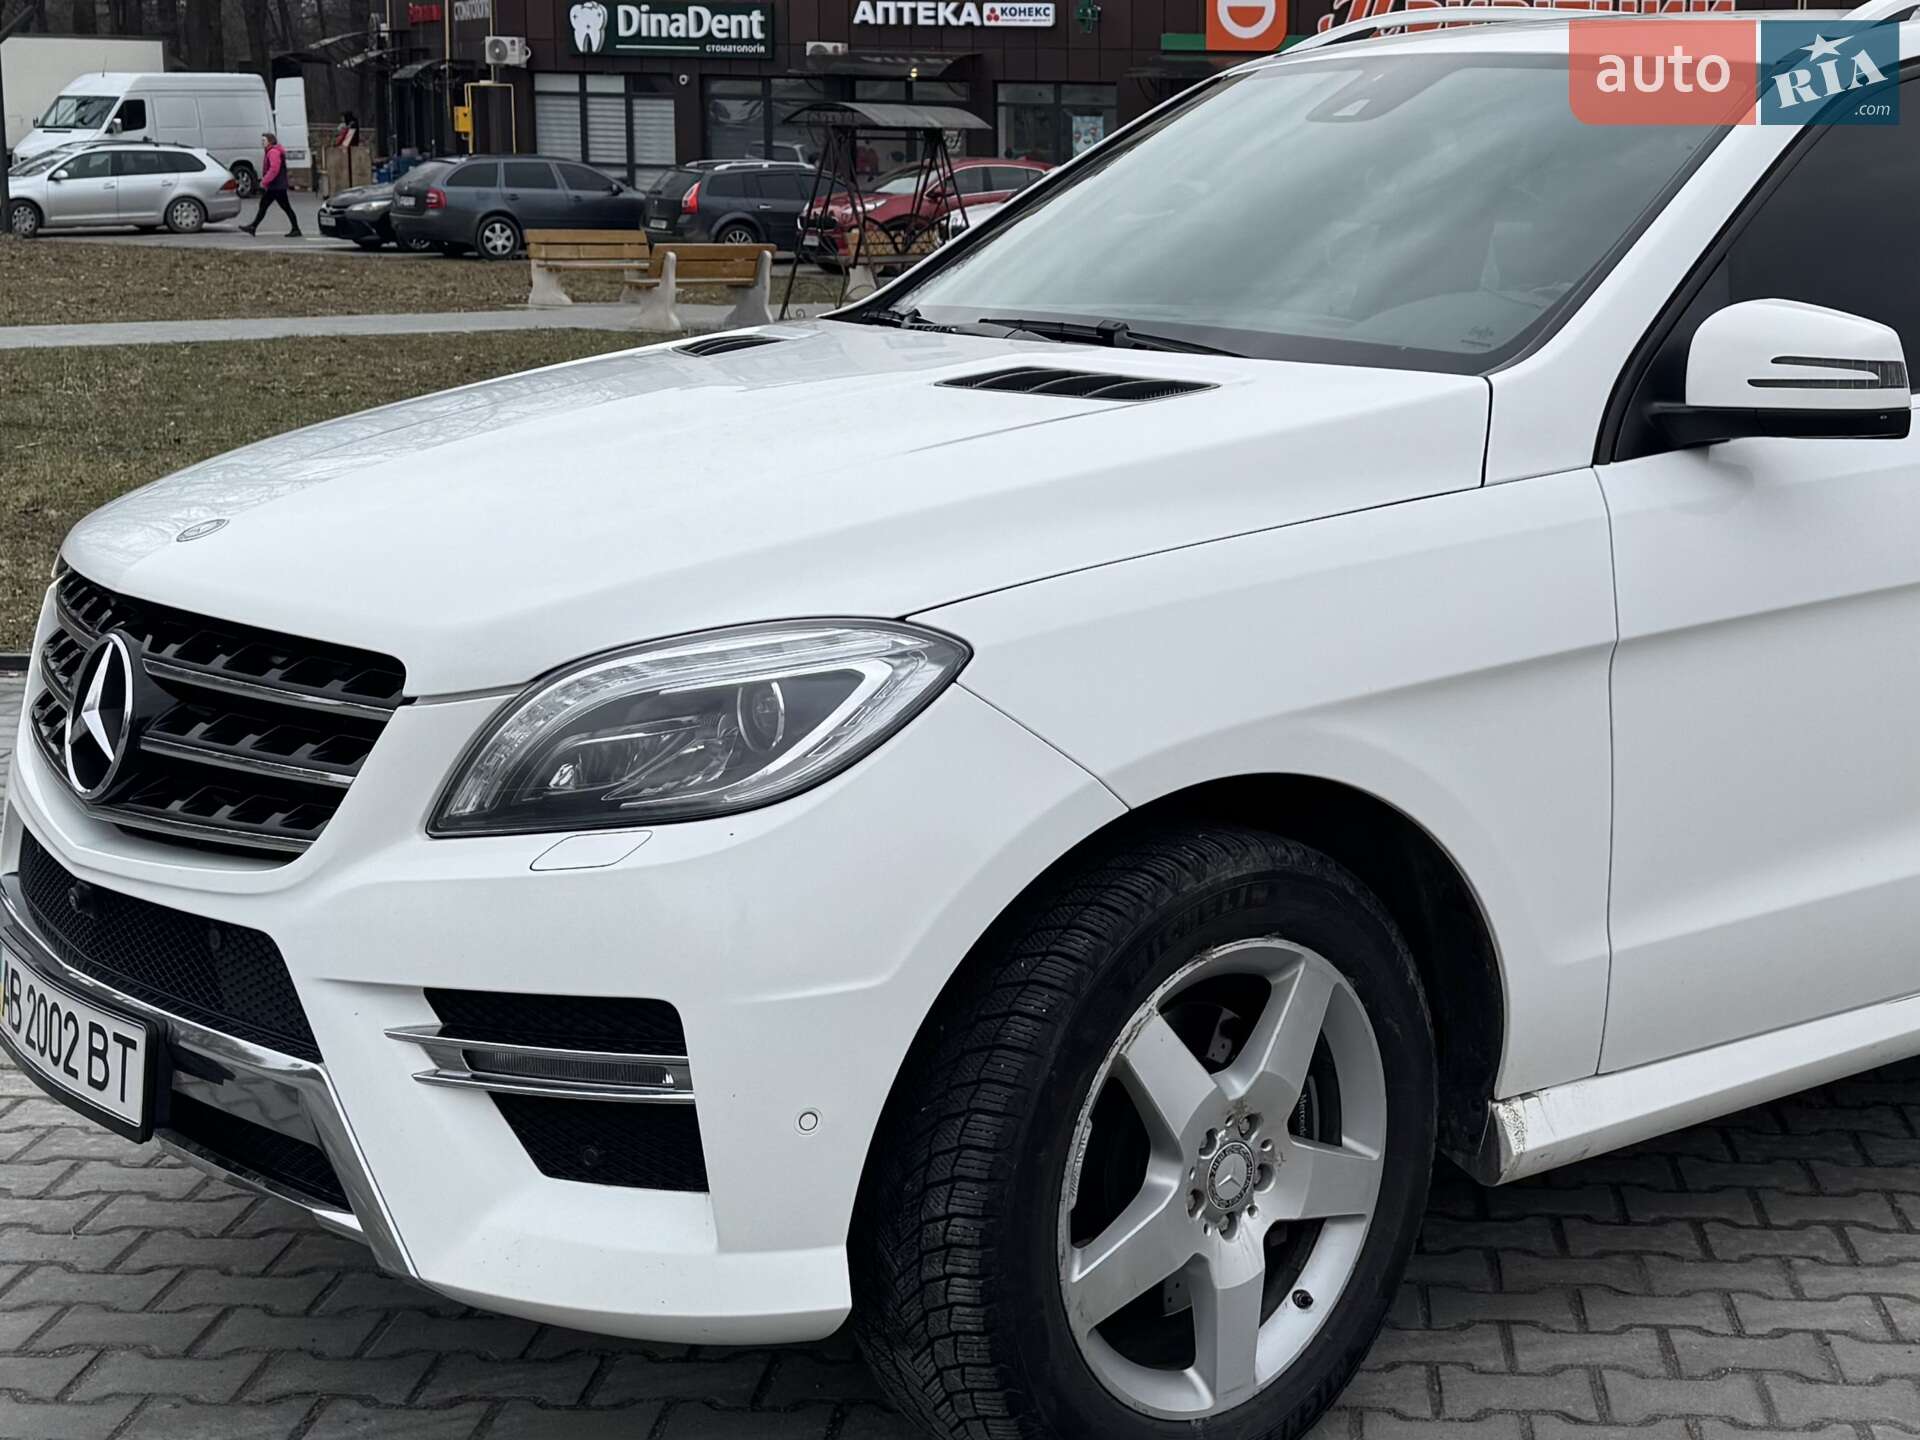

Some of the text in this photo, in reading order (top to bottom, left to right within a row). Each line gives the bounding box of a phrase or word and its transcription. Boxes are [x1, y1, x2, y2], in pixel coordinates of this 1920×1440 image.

[617, 4, 766, 40] DinaDent
[853, 1, 982, 26] АПТЕКА
[1000, 7, 1050, 18] КОНЕКС
[705, 42, 766, 54] стоматологія
[25, 984, 80, 1081] 2002
[87, 1020, 138, 1103] BT
